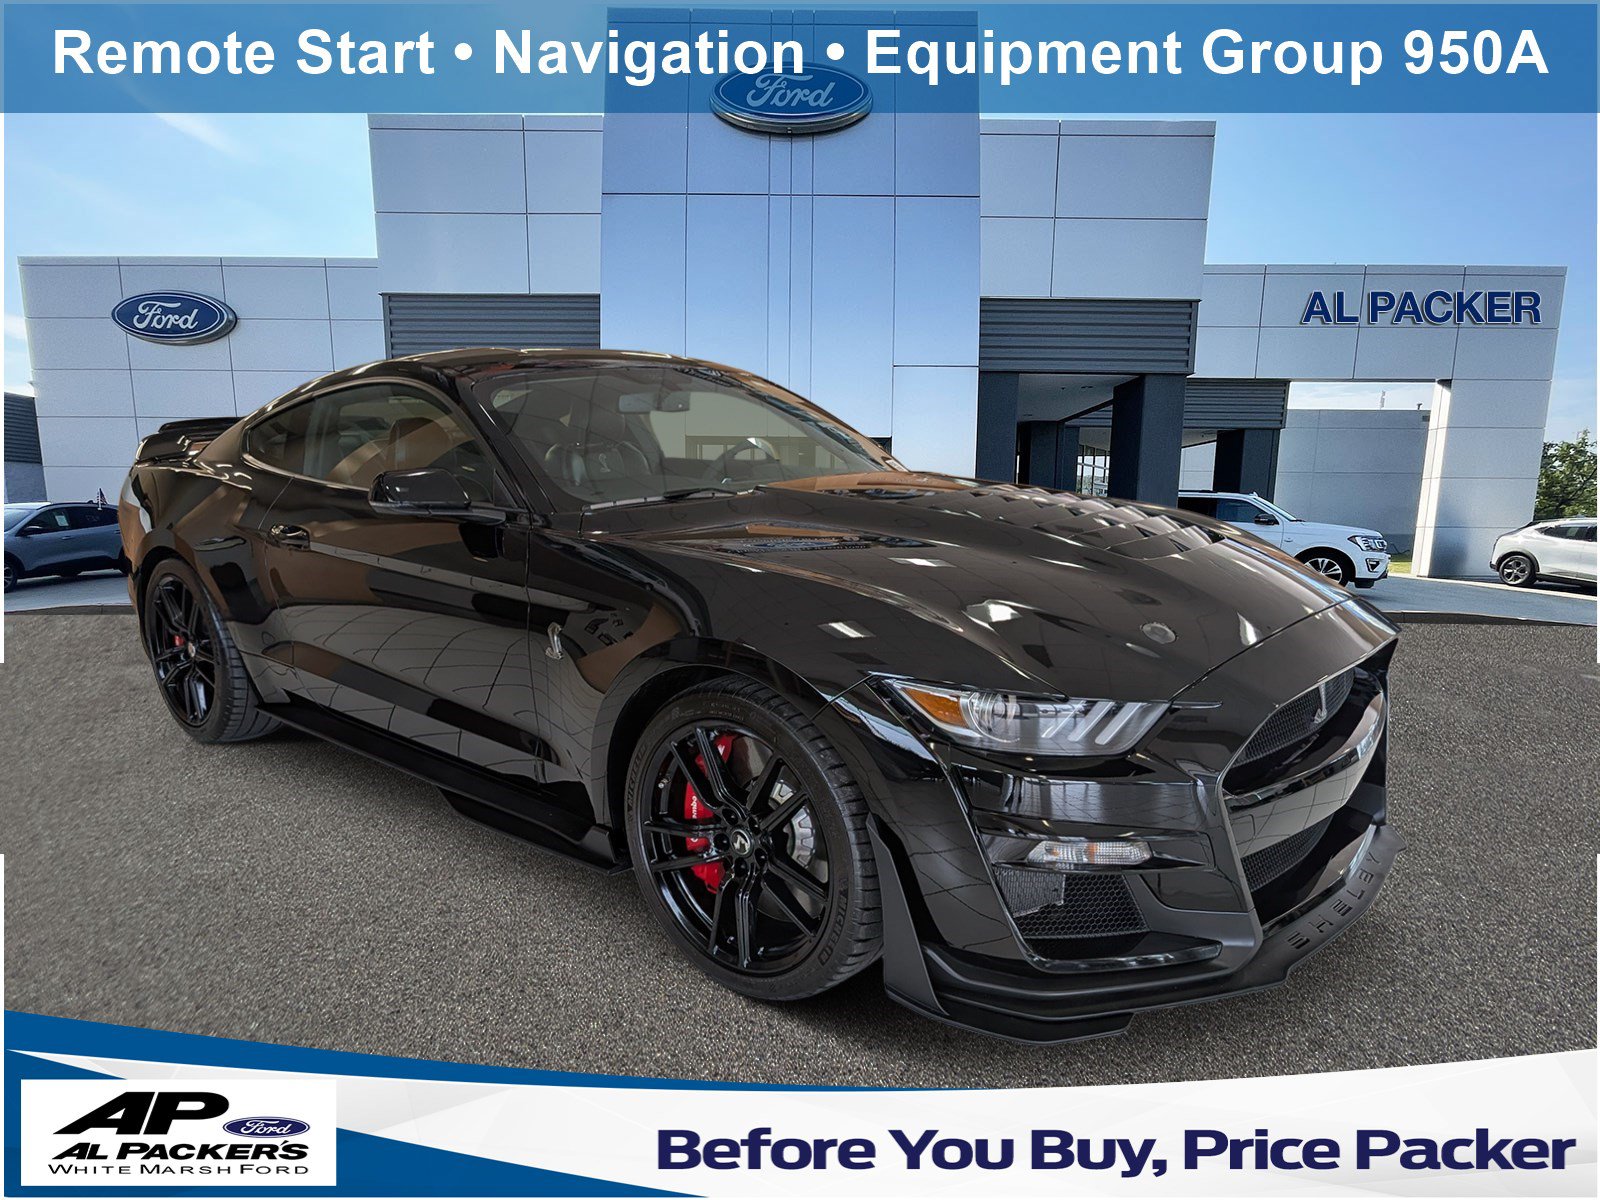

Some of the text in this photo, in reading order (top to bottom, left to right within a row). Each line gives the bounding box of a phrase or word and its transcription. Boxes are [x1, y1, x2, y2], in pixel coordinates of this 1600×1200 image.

[746, 73, 836, 107] Ford
[132, 300, 199, 329] Ford
[1302, 289, 1544, 325] AL PACKER
[1286, 851, 1381, 951] SHELBY
